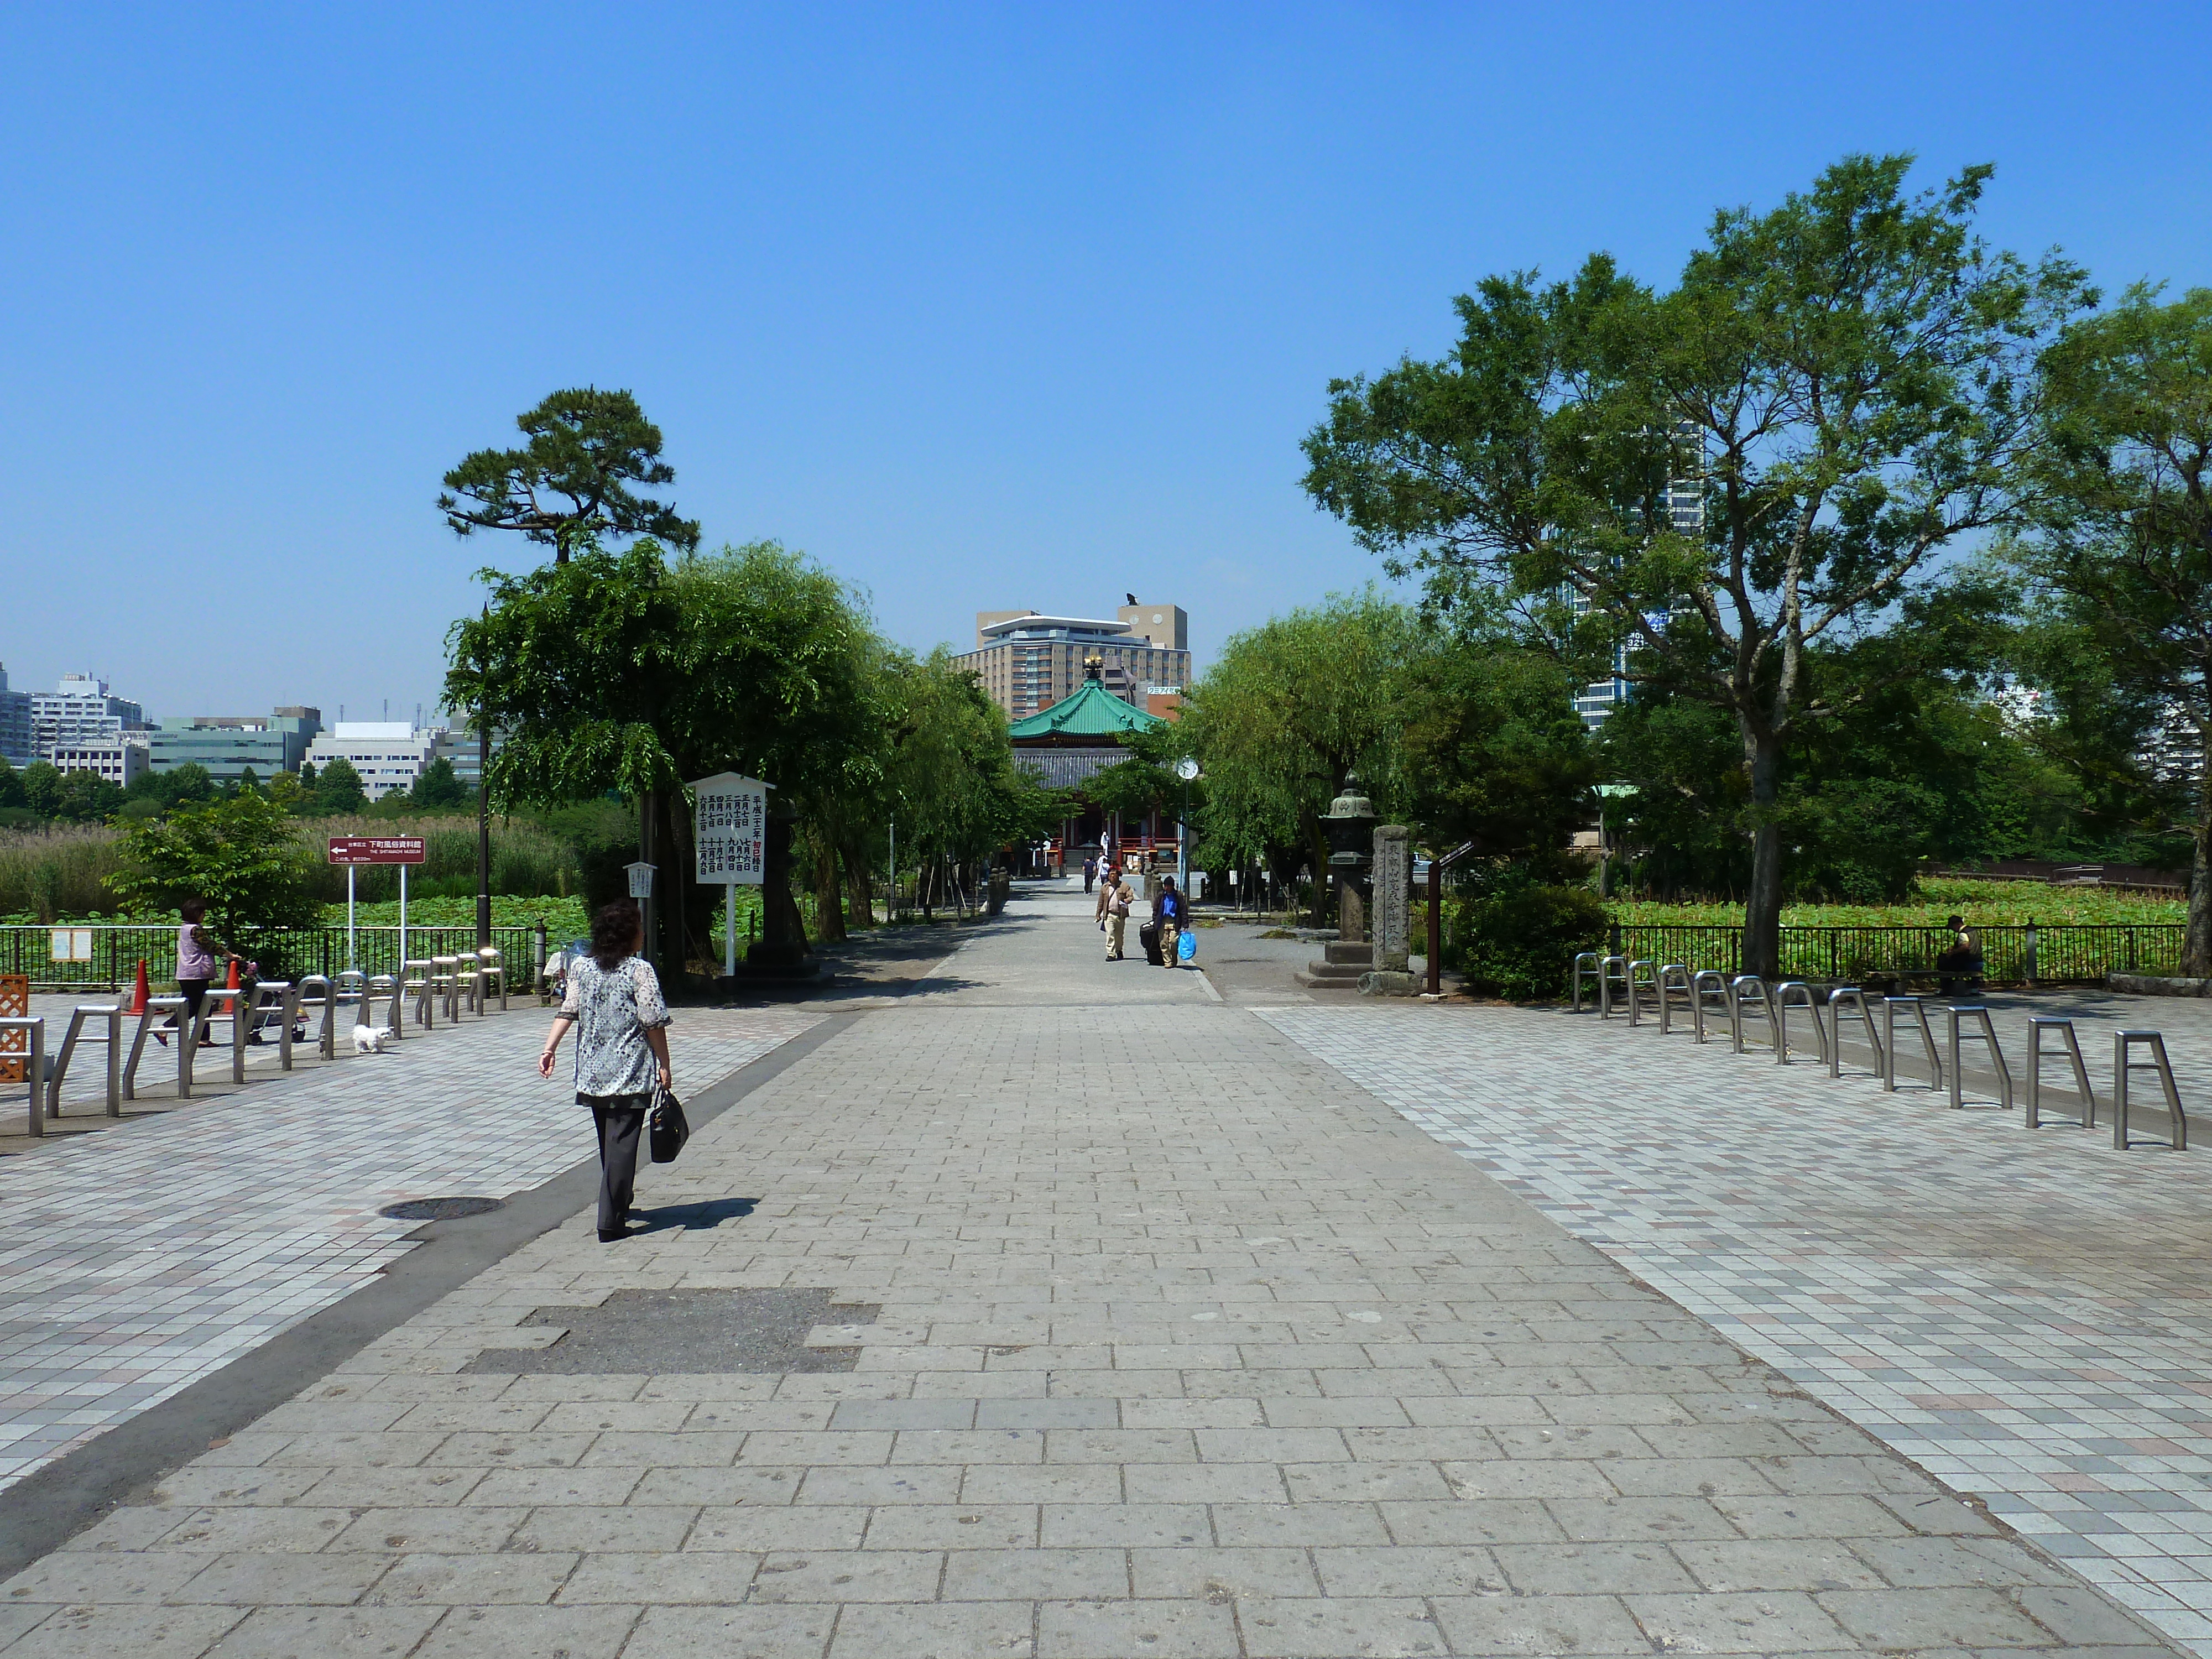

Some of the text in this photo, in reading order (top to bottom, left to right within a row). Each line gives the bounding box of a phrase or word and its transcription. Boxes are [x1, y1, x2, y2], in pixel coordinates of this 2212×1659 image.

[699, 795, 707, 831] 六月十二日
[742, 795, 750, 826] 正月七日
[699, 837, 708, 875] 十二月九日
[708, 837, 716, 873] 十一月三日
[716, 837, 724, 871] 十月十日
[728, 837, 736, 870] 九月四日
